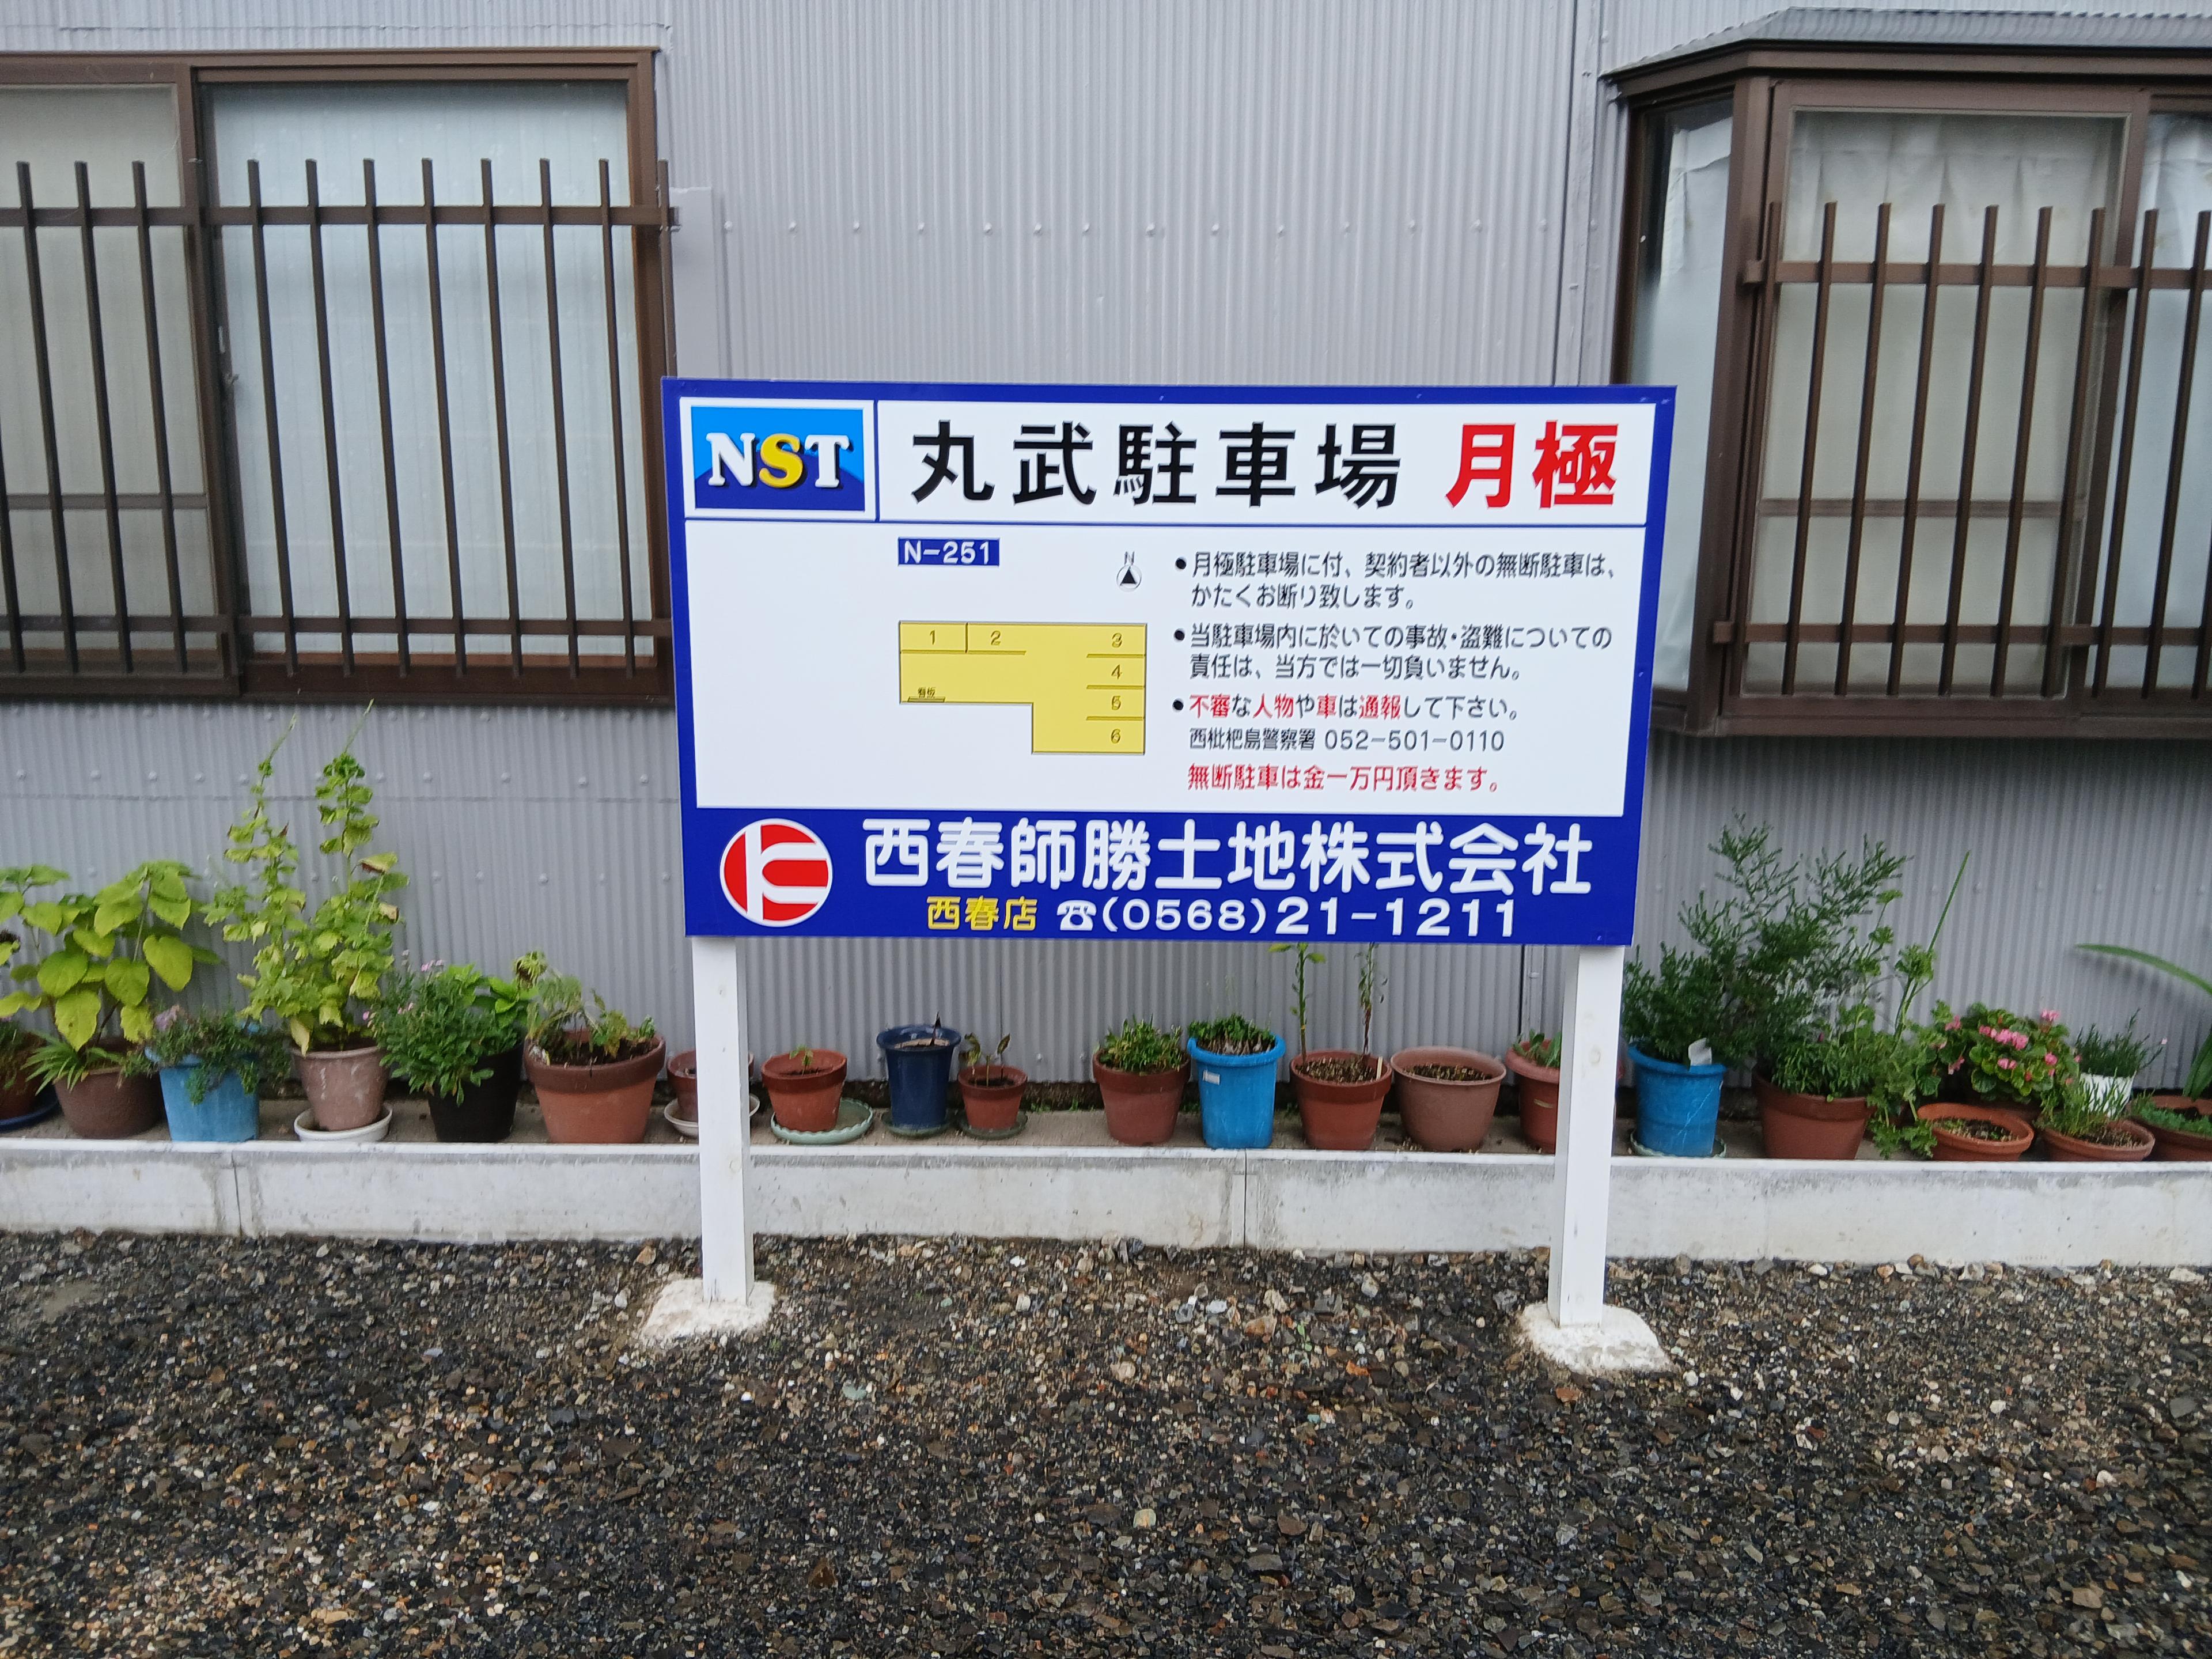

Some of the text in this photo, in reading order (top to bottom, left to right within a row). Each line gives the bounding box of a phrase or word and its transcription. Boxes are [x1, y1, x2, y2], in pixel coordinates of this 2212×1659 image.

[706, 431, 851, 488] NST
[911, 419, 1620, 510] 丸武駐車場 月極
[903, 540, 991, 563] N-251
[1124, 551, 1134, 565] N
[1192, 551, 1614, 578] 月極駐車場に付、契約者以外の無断駐車は、
[1191, 583, 1414, 609] かたくお断り致します。
[929, 630, 937, 645] 1
[990, 630, 1002, 646] 2
[1111, 632, 1123, 648] 3
[1111, 664, 1123, 680] 4
[1189, 653, 1520, 680] 責任は、当方では一切負いません。
[1111, 695, 1122, 711] 5
[1189, 694, 1517, 720] 不審な人物や車は通報して下さい。
[1110, 728, 1122, 744] 6
[1189, 727, 1316, 752] 西枇杷島警察署
[1187, 763, 1498, 792] 無断駐車は金一万円頂きます。
[862, 817, 1593, 896] 西春師勝土地株式会社
[926, 896, 1037, 931] 西春店
